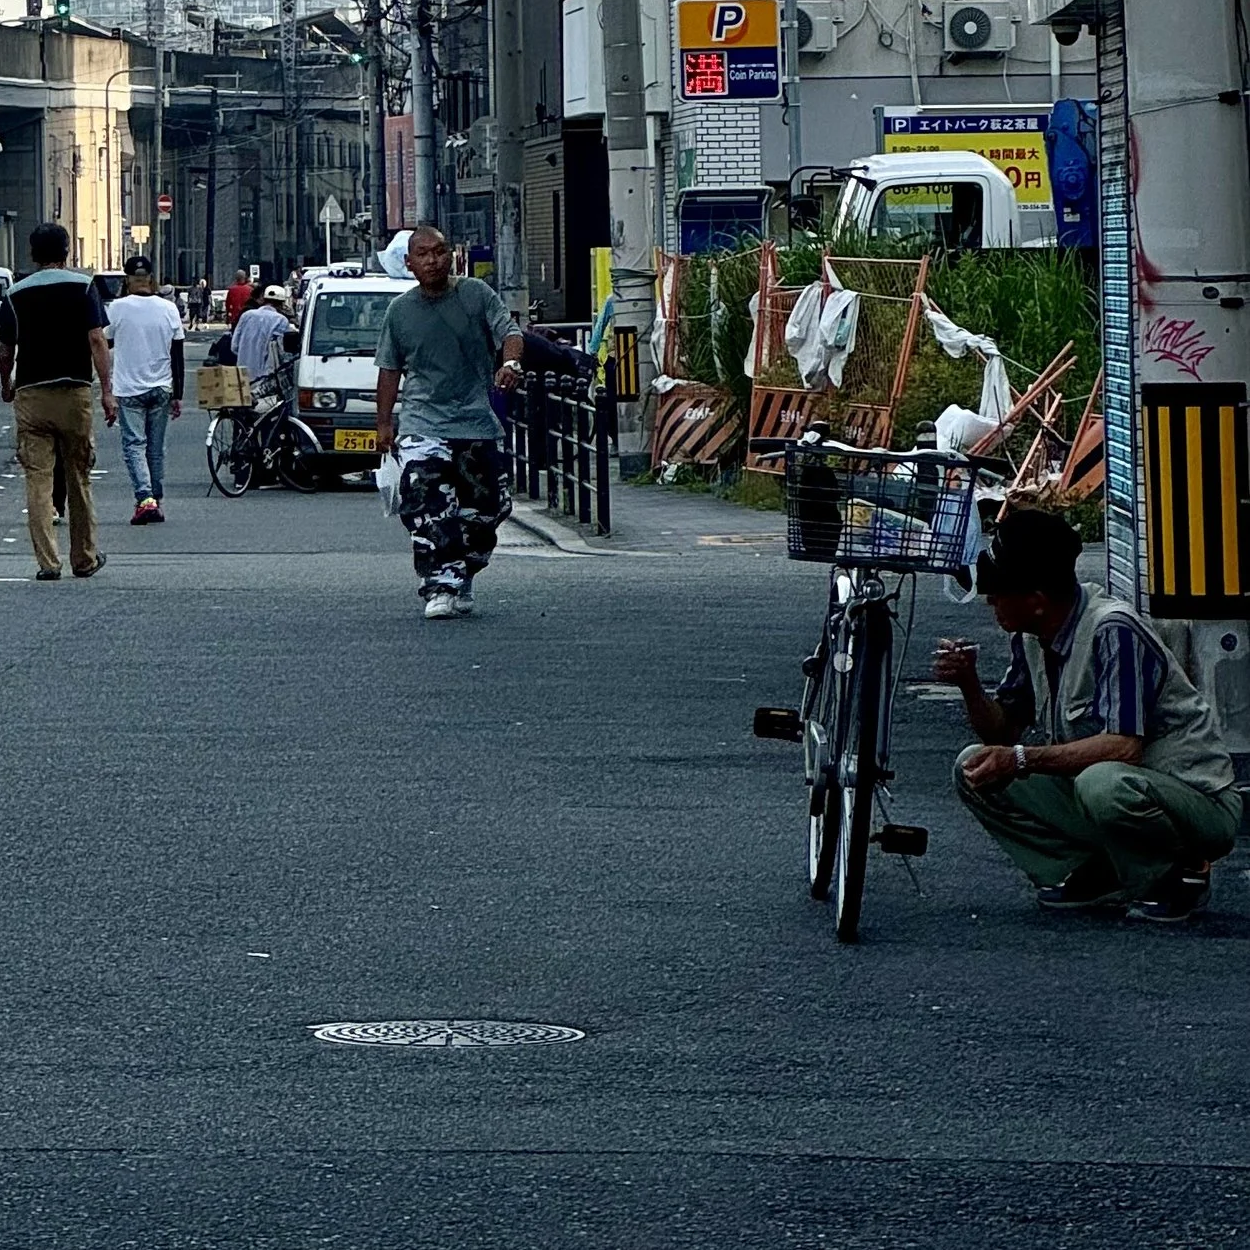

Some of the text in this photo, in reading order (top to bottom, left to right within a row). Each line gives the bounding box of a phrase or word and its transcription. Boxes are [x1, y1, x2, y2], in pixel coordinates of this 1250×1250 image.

[711, 2, 746, 41] P
[685, 54, 724, 94] 満
[729, 69, 777, 81] Coin Parking
